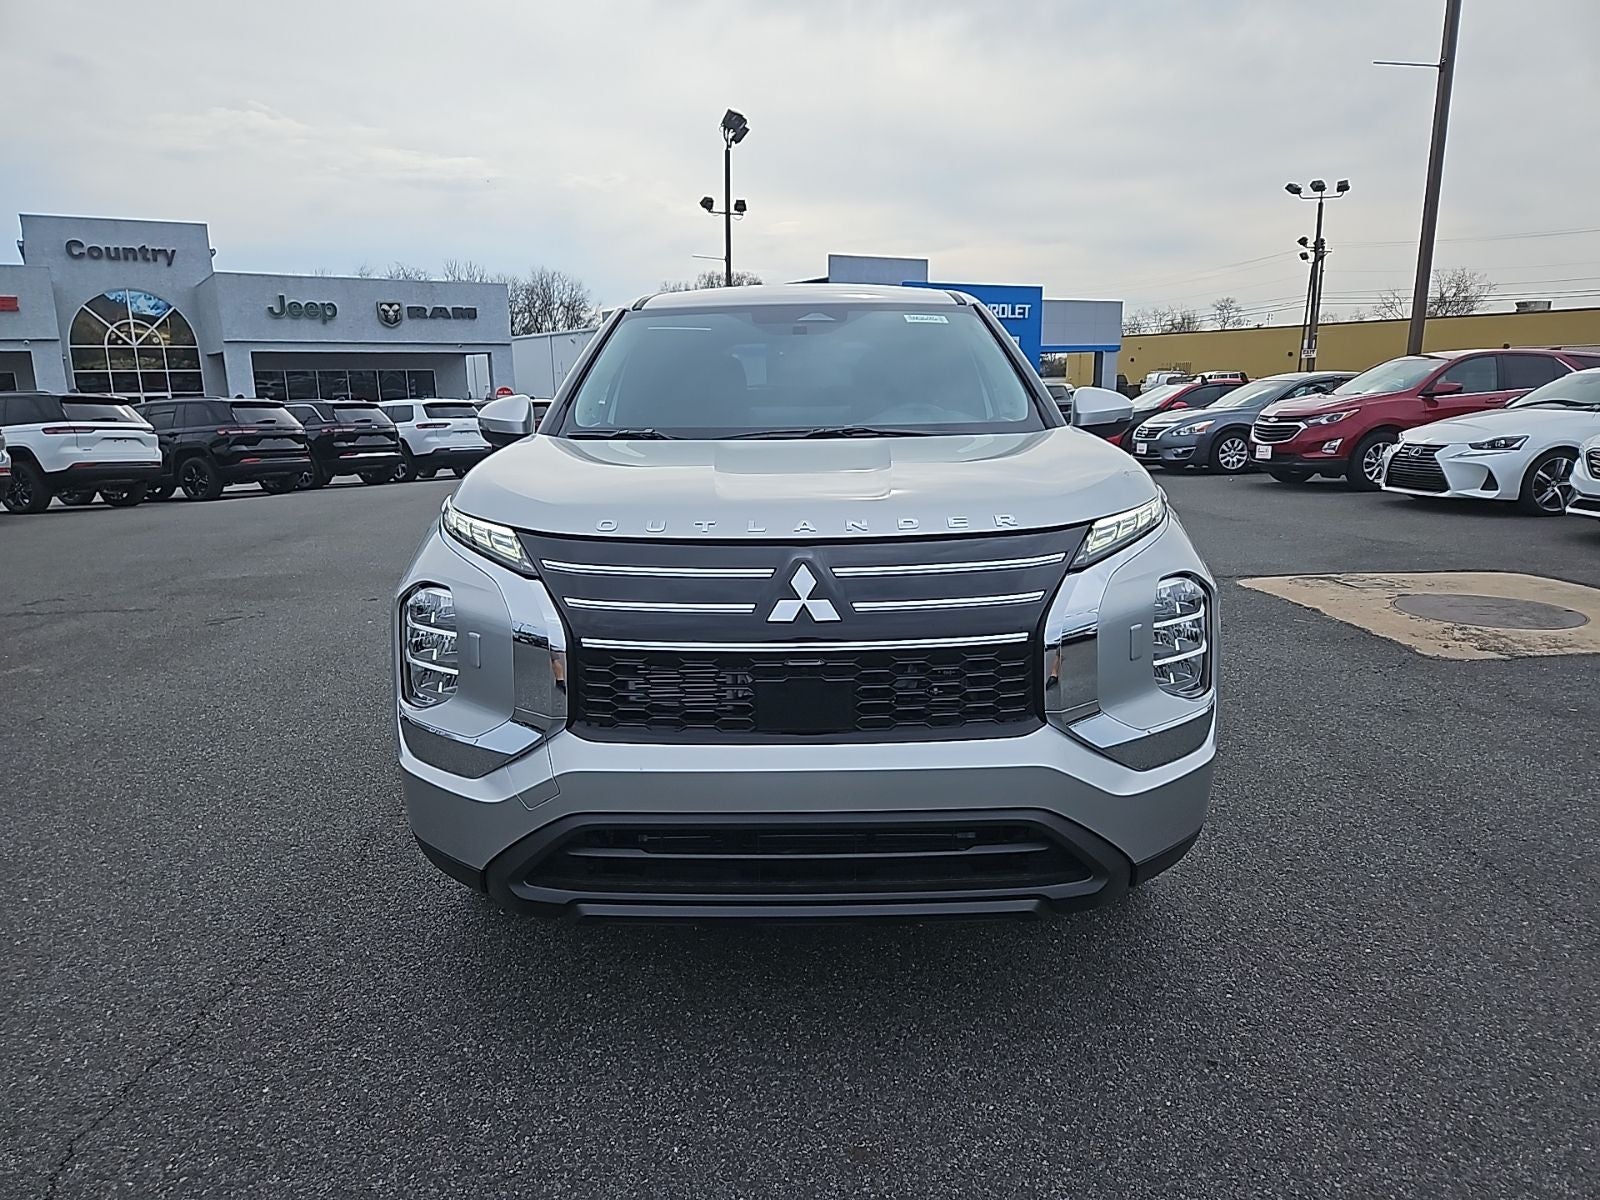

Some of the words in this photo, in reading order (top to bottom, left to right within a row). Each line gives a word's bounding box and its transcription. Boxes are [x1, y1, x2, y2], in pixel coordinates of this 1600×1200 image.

[65, 239, 176, 267] Country
[267, 294, 338, 325] Jeep
[406, 305, 478, 320] RAM
[595, 514, 1018, 534] OUTLANDER
